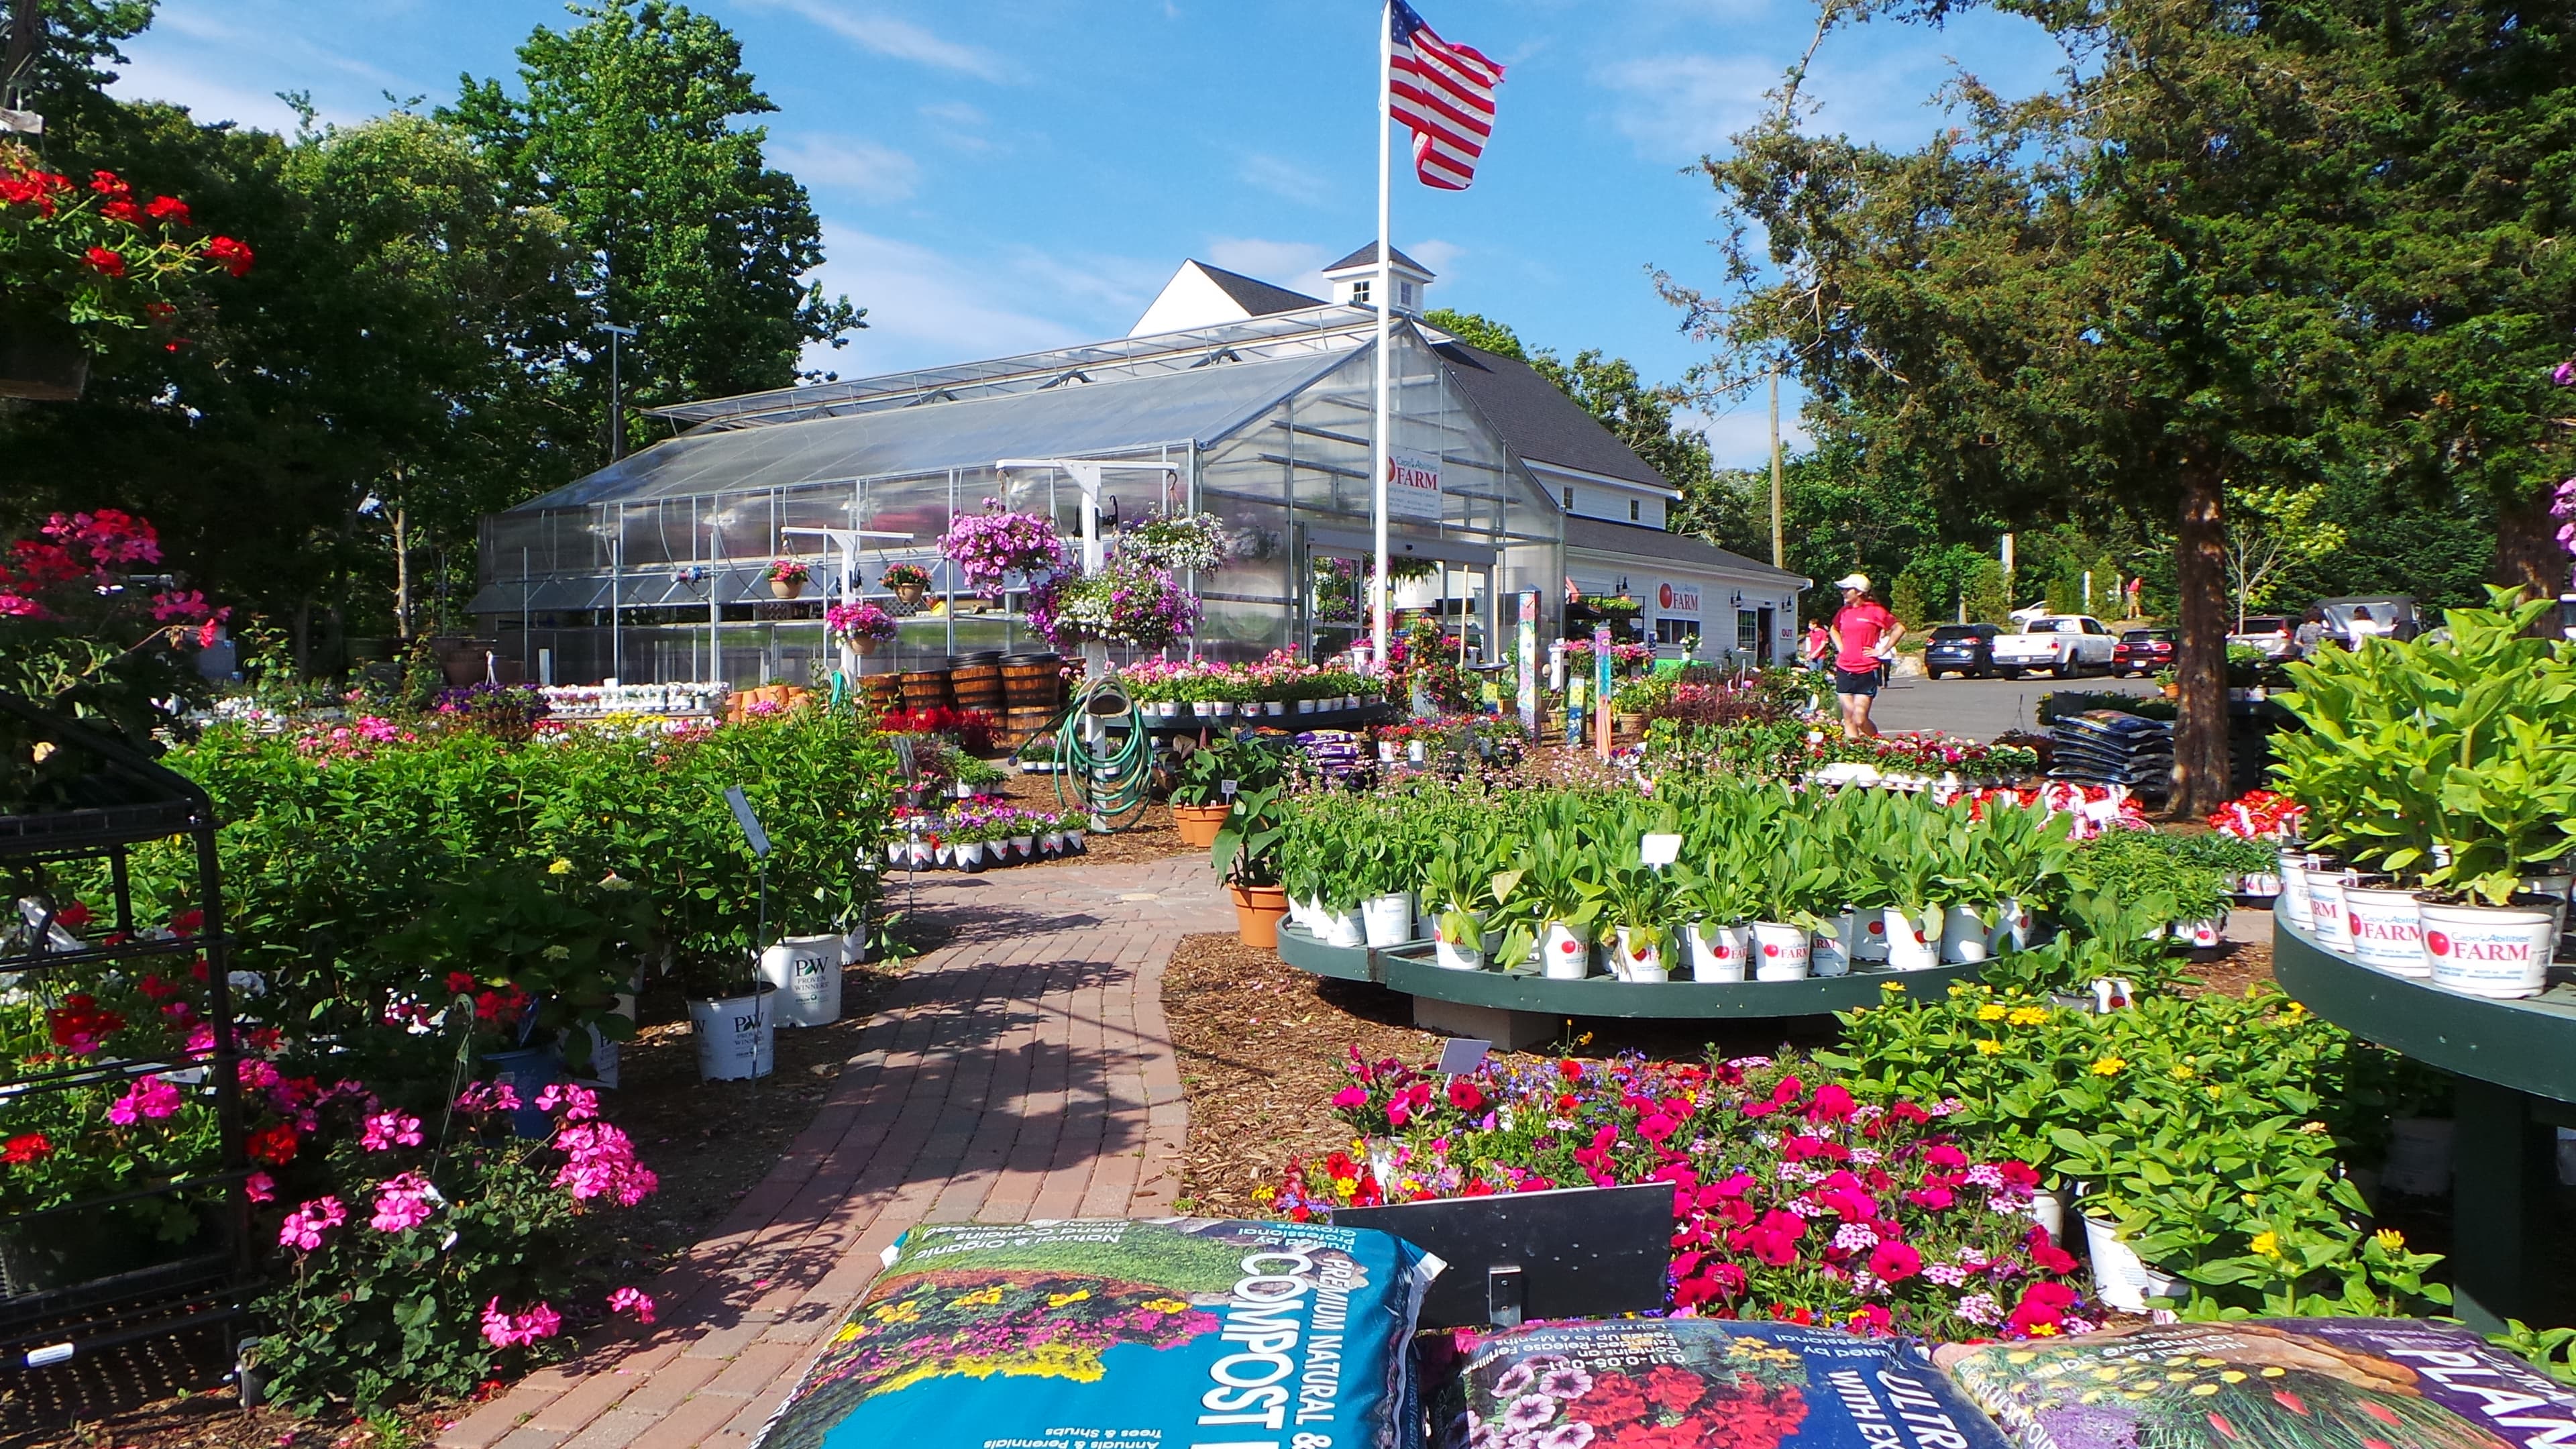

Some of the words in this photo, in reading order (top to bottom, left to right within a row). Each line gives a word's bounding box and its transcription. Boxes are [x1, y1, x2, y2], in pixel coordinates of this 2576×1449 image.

[1397, 467, 1438, 490] FARM
[1673, 592, 1699, 611] FARM
[1781, 629, 1792, 637] OUT
[2452, 942, 2531, 961] FARM
[794, 957, 829, 977] PW
[797, 975, 826, 984] PROVEN
[794, 982, 829, 991] WINNERS
[955, 1228, 1054, 1240] Contains
[1060, 1227, 1126, 1236] Blend
[1276, 1224, 1358, 1237] Growers
[1014, 1238, 1029, 1246] &
[1034, 1234, 1121, 1243] Natural
[1238, 1228, 1356, 1246] Professional
[1253, 1235, 1282, 1246] by
[913, 1240, 1007, 1259] Organic
[1285, 1238, 1355, 1253] Trusted
[1310, 1258, 1354, 1331] PREMIUM
[1196, 1252, 1313, 1430] COMPOST
[1495, 1334, 1556, 1346] Months
[1560, 1334, 1572, 1342] 6
[1596, 1334, 1620, 1342] Up
[1621, 1332, 1674, 1342] Feeds
[2206, 1334, 2234, 1342] to
[1522, 1339, 1678, 1353] Extended-Release
[1605, 1346, 1682, 1356] Contains
[1803, 1345, 1831, 1357] by
[2102, 1337, 2204, 1357] Improve
[2156, 1340, 2248, 1358] Natural
[1577, 1350, 1599, 1358] an
[1833, 1347, 1908, 1371] Trusted
[2130, 1352, 2151, 1362] &
[1549, 1354, 1686, 1372] 0.11-0.05-0.11
[1294, 1334, 1344, 1426] NATURAL
[1827, 1371, 1887, 1420] WITH
[1876, 1370, 1969, 1449] ULTR
[1044, 1427, 1100, 1438] Shrubs
[1104, 1429, 1116, 1439] &
[1120, 1429, 1163, 1439] Trees
[983, 1438, 1069, 1449] Perennials
[1073, 1440, 1086, 1449] &
[1090, 1440, 1161, 1449] Annuals
